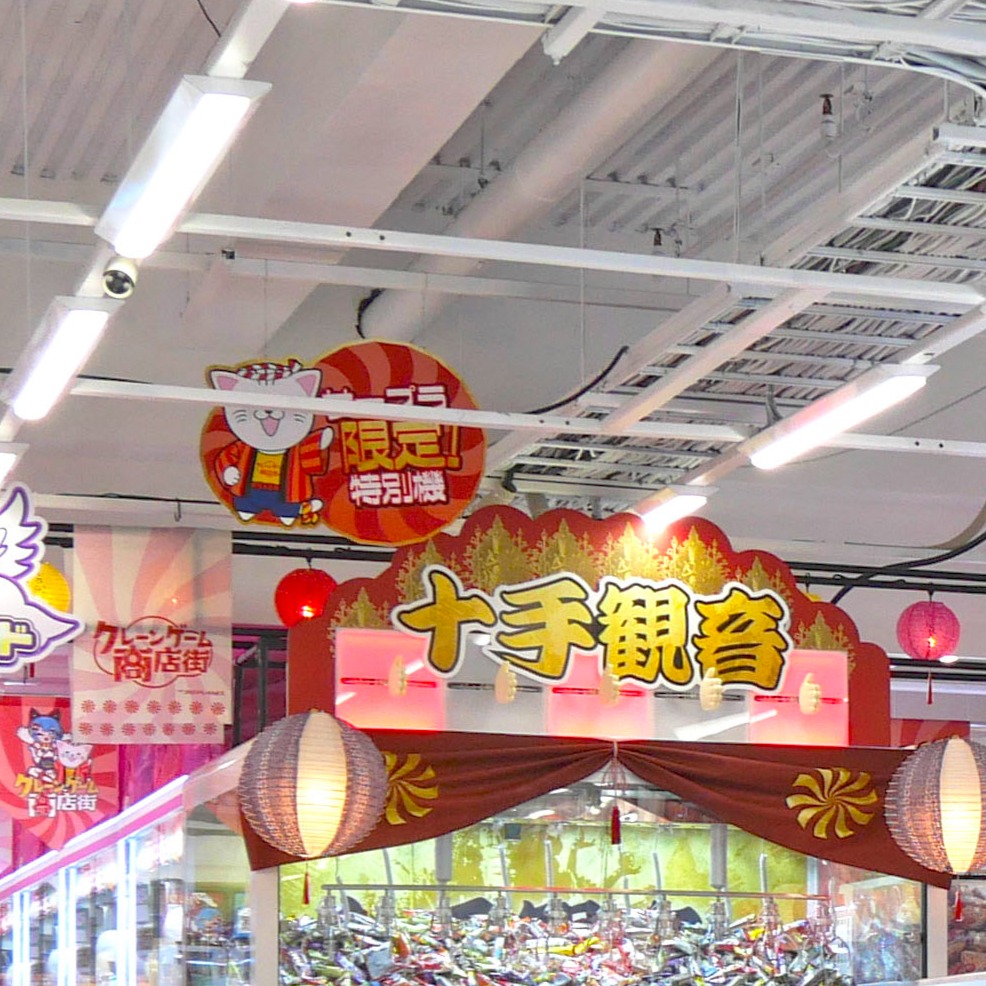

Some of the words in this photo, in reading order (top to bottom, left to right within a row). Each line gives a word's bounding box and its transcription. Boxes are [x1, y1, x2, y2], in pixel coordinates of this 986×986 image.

[350, 471, 447, 506] 特別機
[93, 620, 213, 654] クレーンゲーム
[398, 568, 788, 688] 十手観音
[113, 646, 210, 682] 商店街
[28, 791, 98, 817] 商店街
